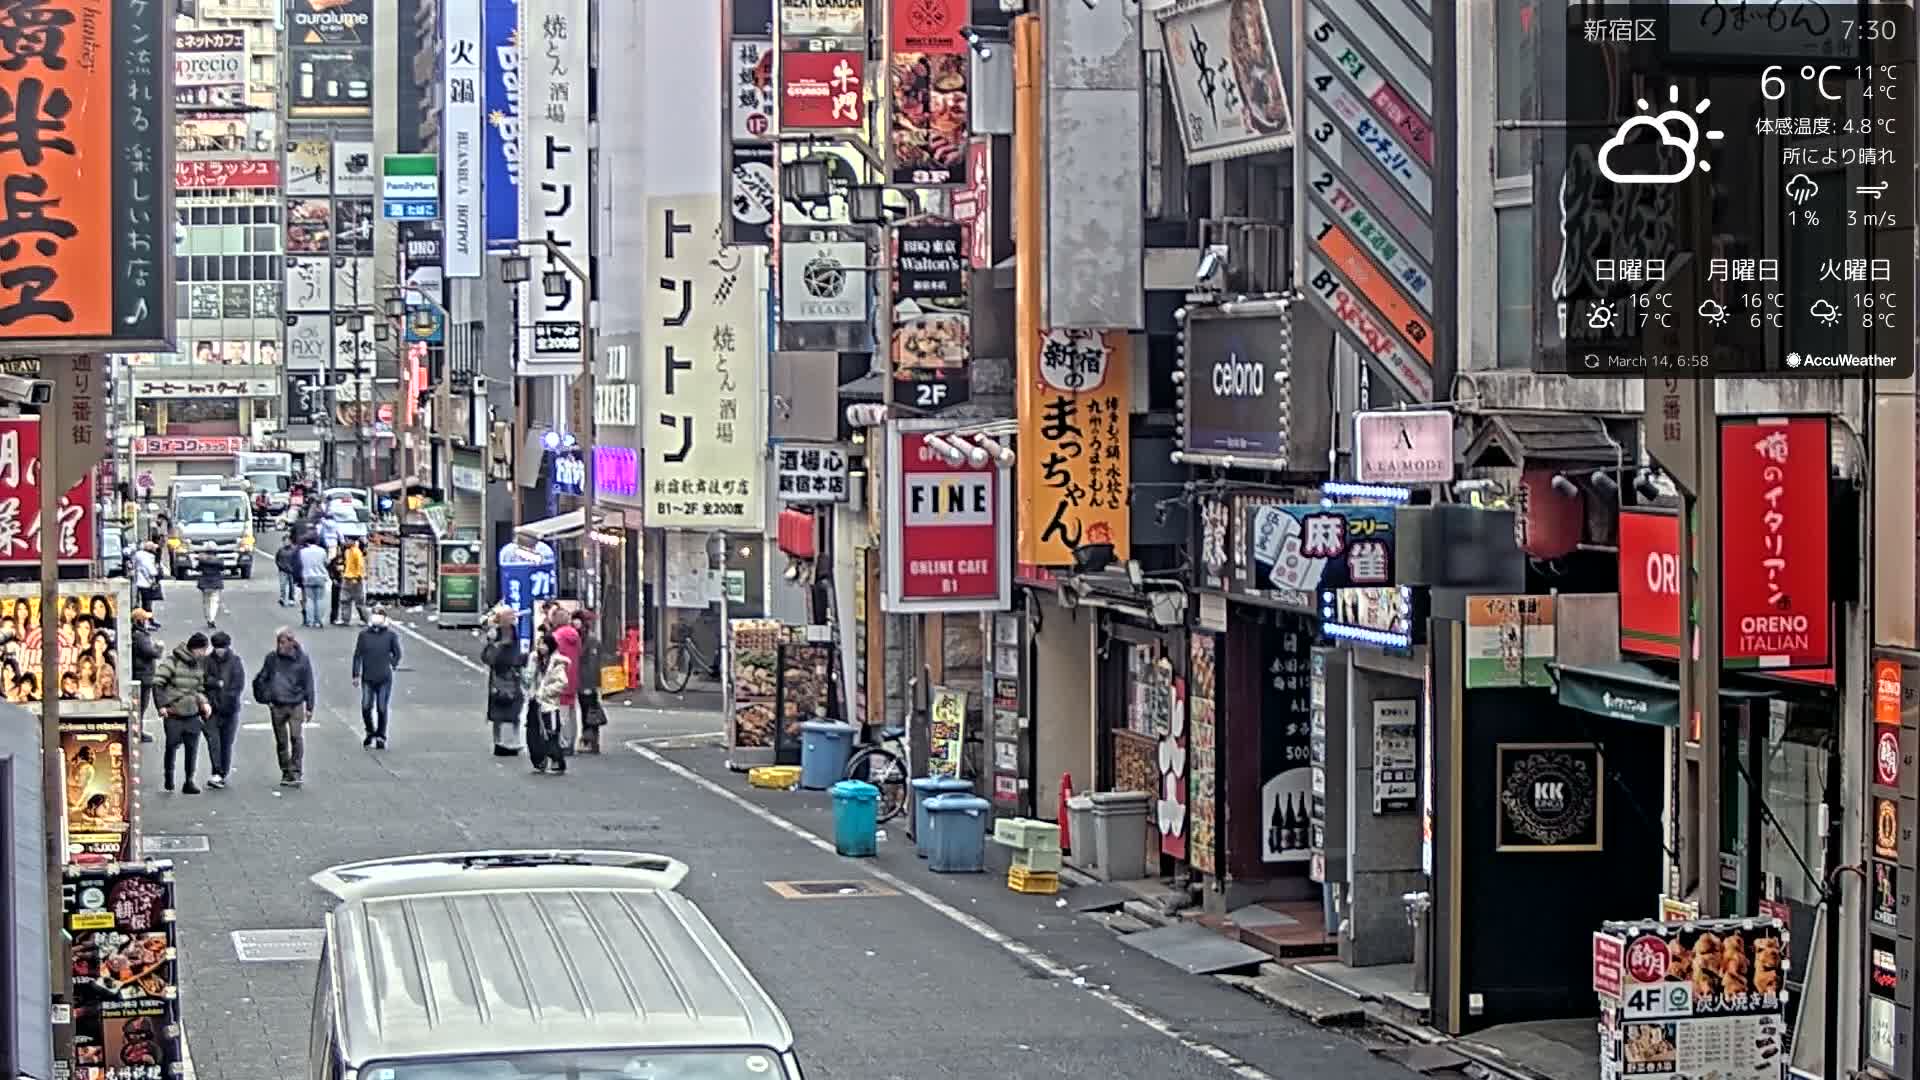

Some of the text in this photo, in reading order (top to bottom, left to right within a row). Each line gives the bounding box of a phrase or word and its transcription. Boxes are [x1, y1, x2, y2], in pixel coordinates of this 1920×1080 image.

[1314, 23, 1334, 43] 5
[450, 39, 475, 104] 火鍋
[1315, 74, 1332, 92] 4
[1315, 122, 1334, 144] 3
[1313, 173, 1333, 194] 2
[1312, 269, 1339, 298] B1
[659, 208, 692, 464] トントン
[1212, 352, 1265, 398] celona
[916, 384, 948, 406] 2F
[779, 449, 843, 472] 酒場心
[1040, 395, 1086, 549] まっちゃん
[911, 484, 986, 513] FINE
[1348, 518, 1392, 537] フリー
[1755, 431, 1790, 605] 俺のイタリアン
[909, 559, 988, 576] ONLINE CAFE
[1741, 615, 1808, 633] ORENO
[1739, 634, 1809, 652] ITALIAN
[1534, 781, 1564, 800] KK
[1627, 989, 1661, 1012] 4F
